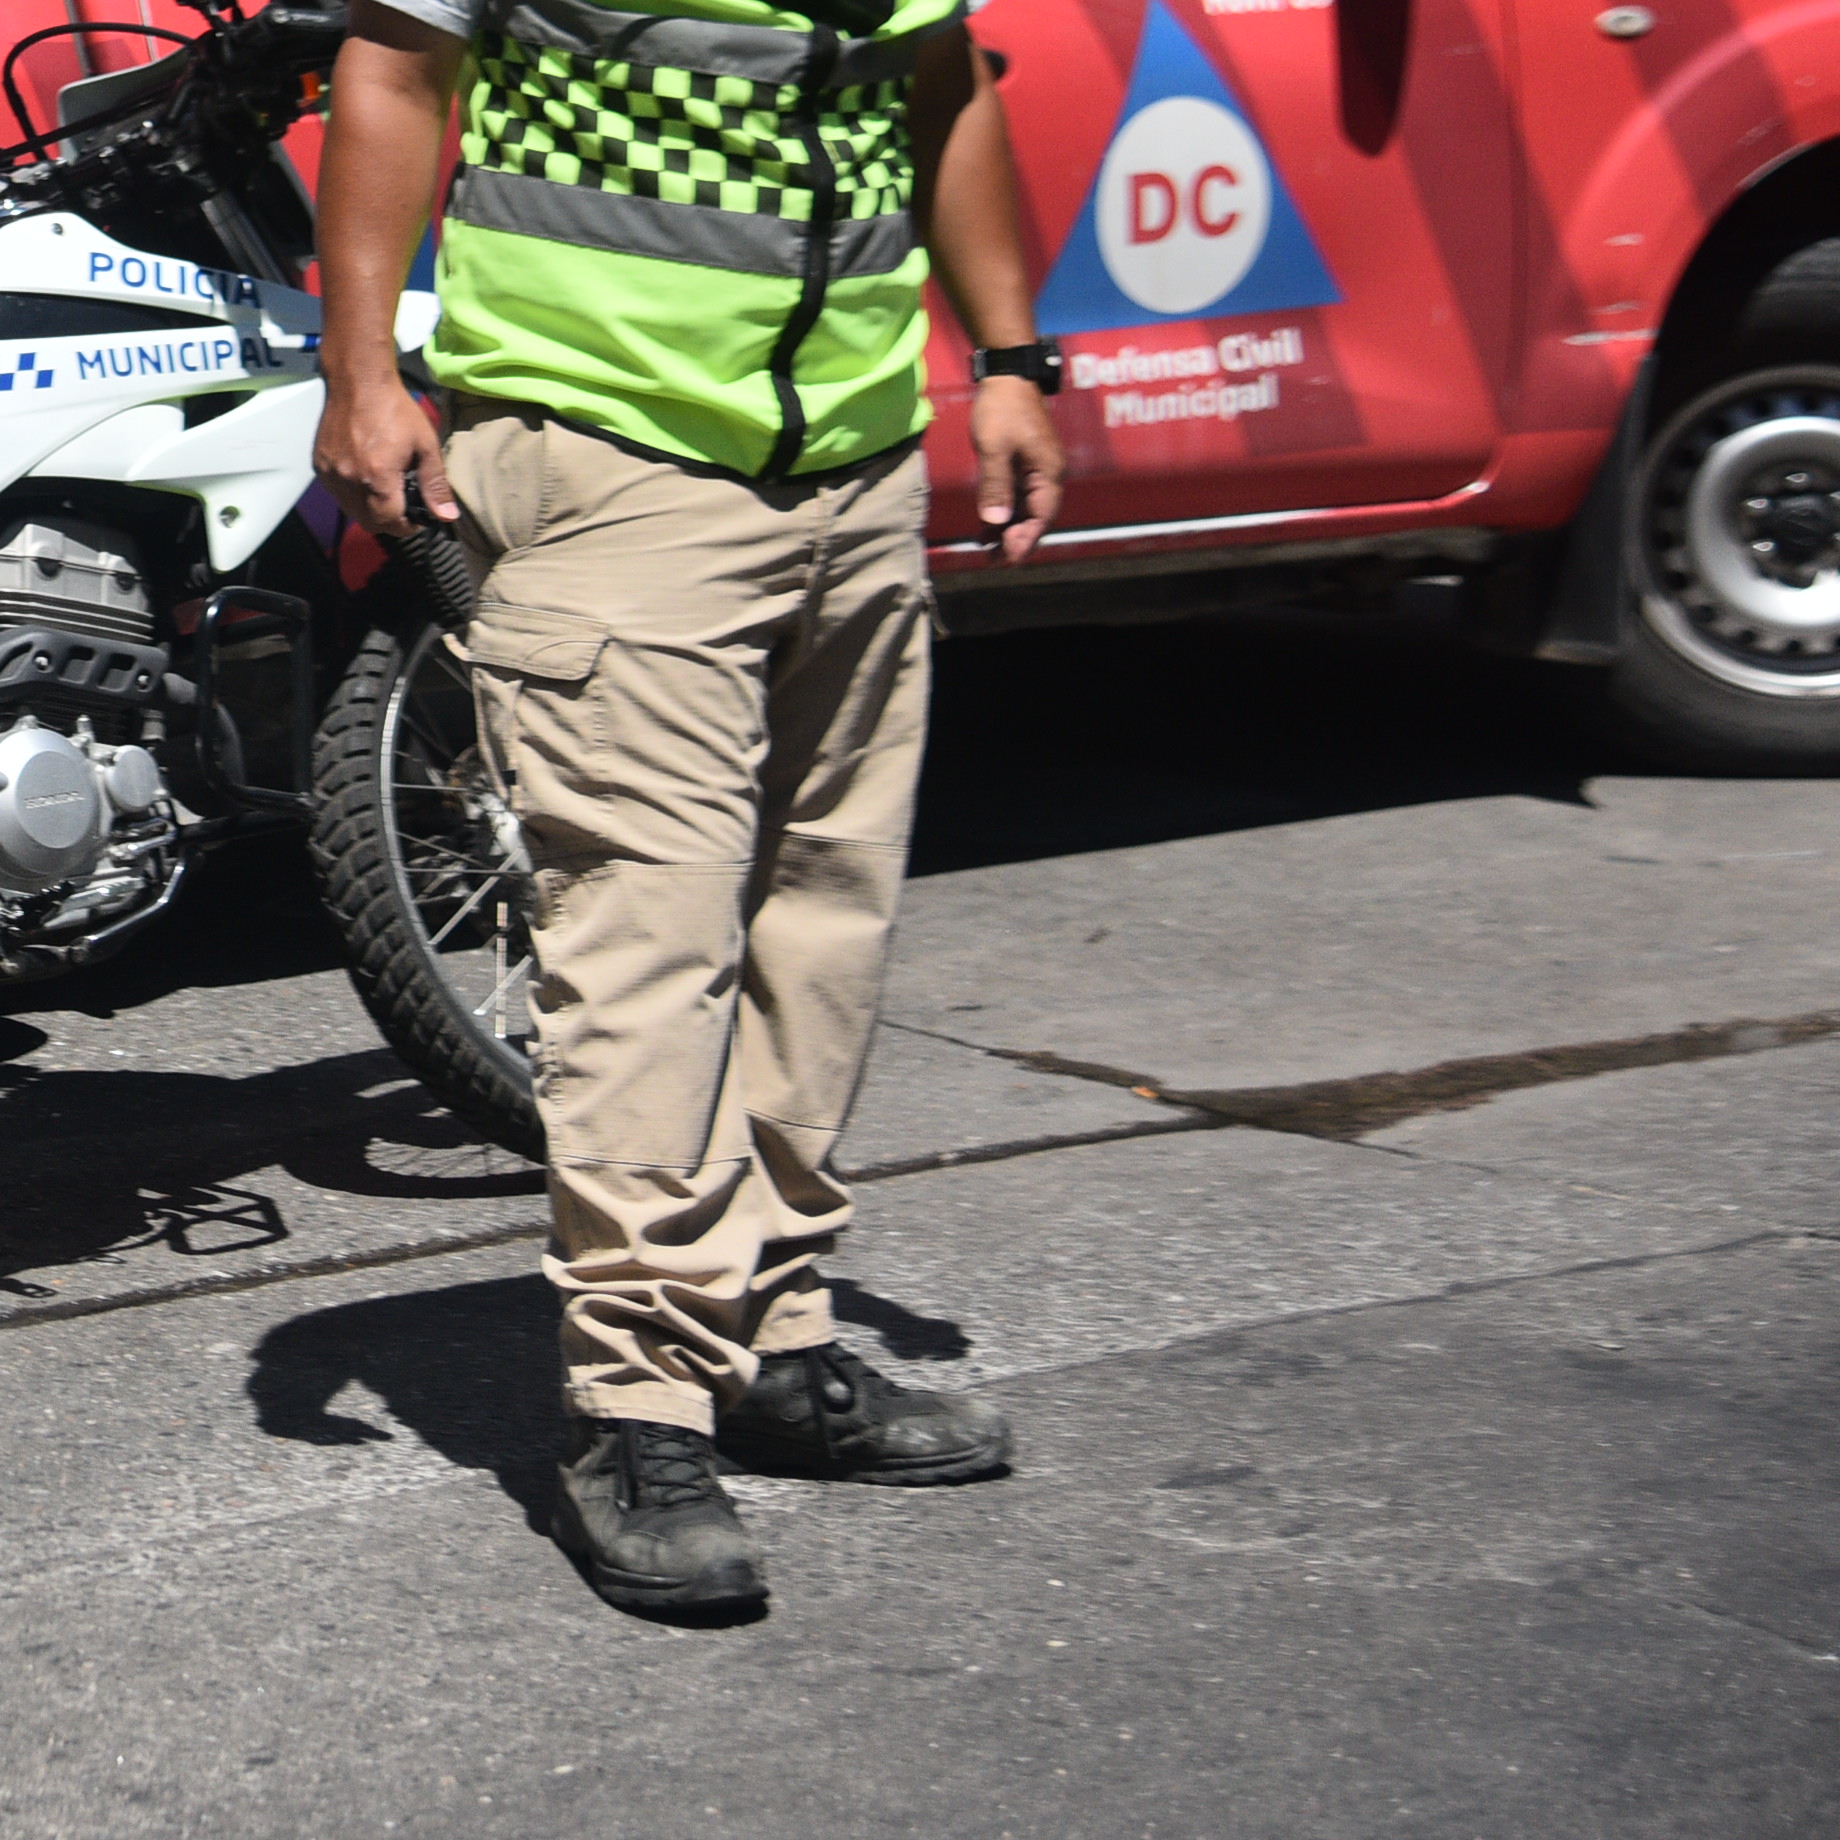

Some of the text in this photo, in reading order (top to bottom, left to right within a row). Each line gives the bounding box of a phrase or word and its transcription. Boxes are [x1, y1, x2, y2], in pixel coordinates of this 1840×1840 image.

[1126, 162, 1242, 246] DC
[88, 252, 262, 309] POLICIA
[76, 337, 284, 381] MUNICIPAL
[1071, 326, 1305, 390] Defensa Civil
[1103, 371, 1281, 429] Municipal
